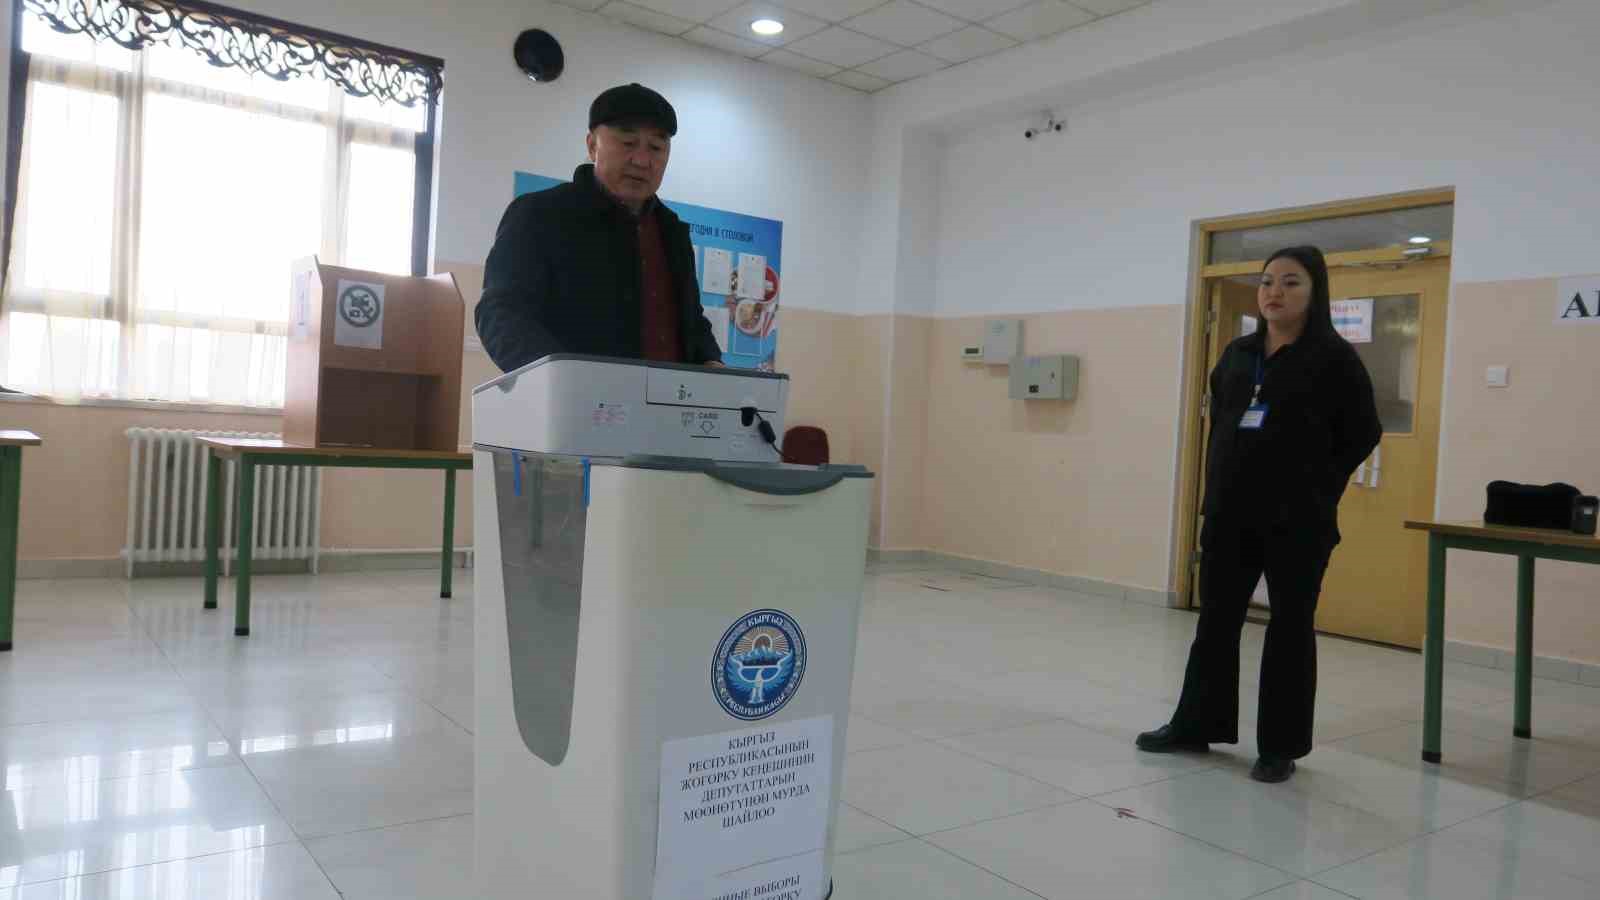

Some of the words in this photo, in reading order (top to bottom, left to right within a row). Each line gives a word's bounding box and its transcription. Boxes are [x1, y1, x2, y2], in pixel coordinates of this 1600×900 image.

[689, 223, 712, 236] ГОДНЯ
[747, 614, 784, 627] КЫРГЫЗ
[728, 731, 776, 750] КЫРГЫЗ
[688, 739, 809, 775] РЕСПУБЛИКАСЫНЫН
[680, 769, 738, 792] ЖОГОРКУ
[701, 772, 796, 803] ДЕПУТАТТАРЫН
[772, 783, 810, 801] МУРДА
[722, 806, 775, 828] ШАЙЛОО
[753, 874, 800, 897] ВЫБОРЫ
